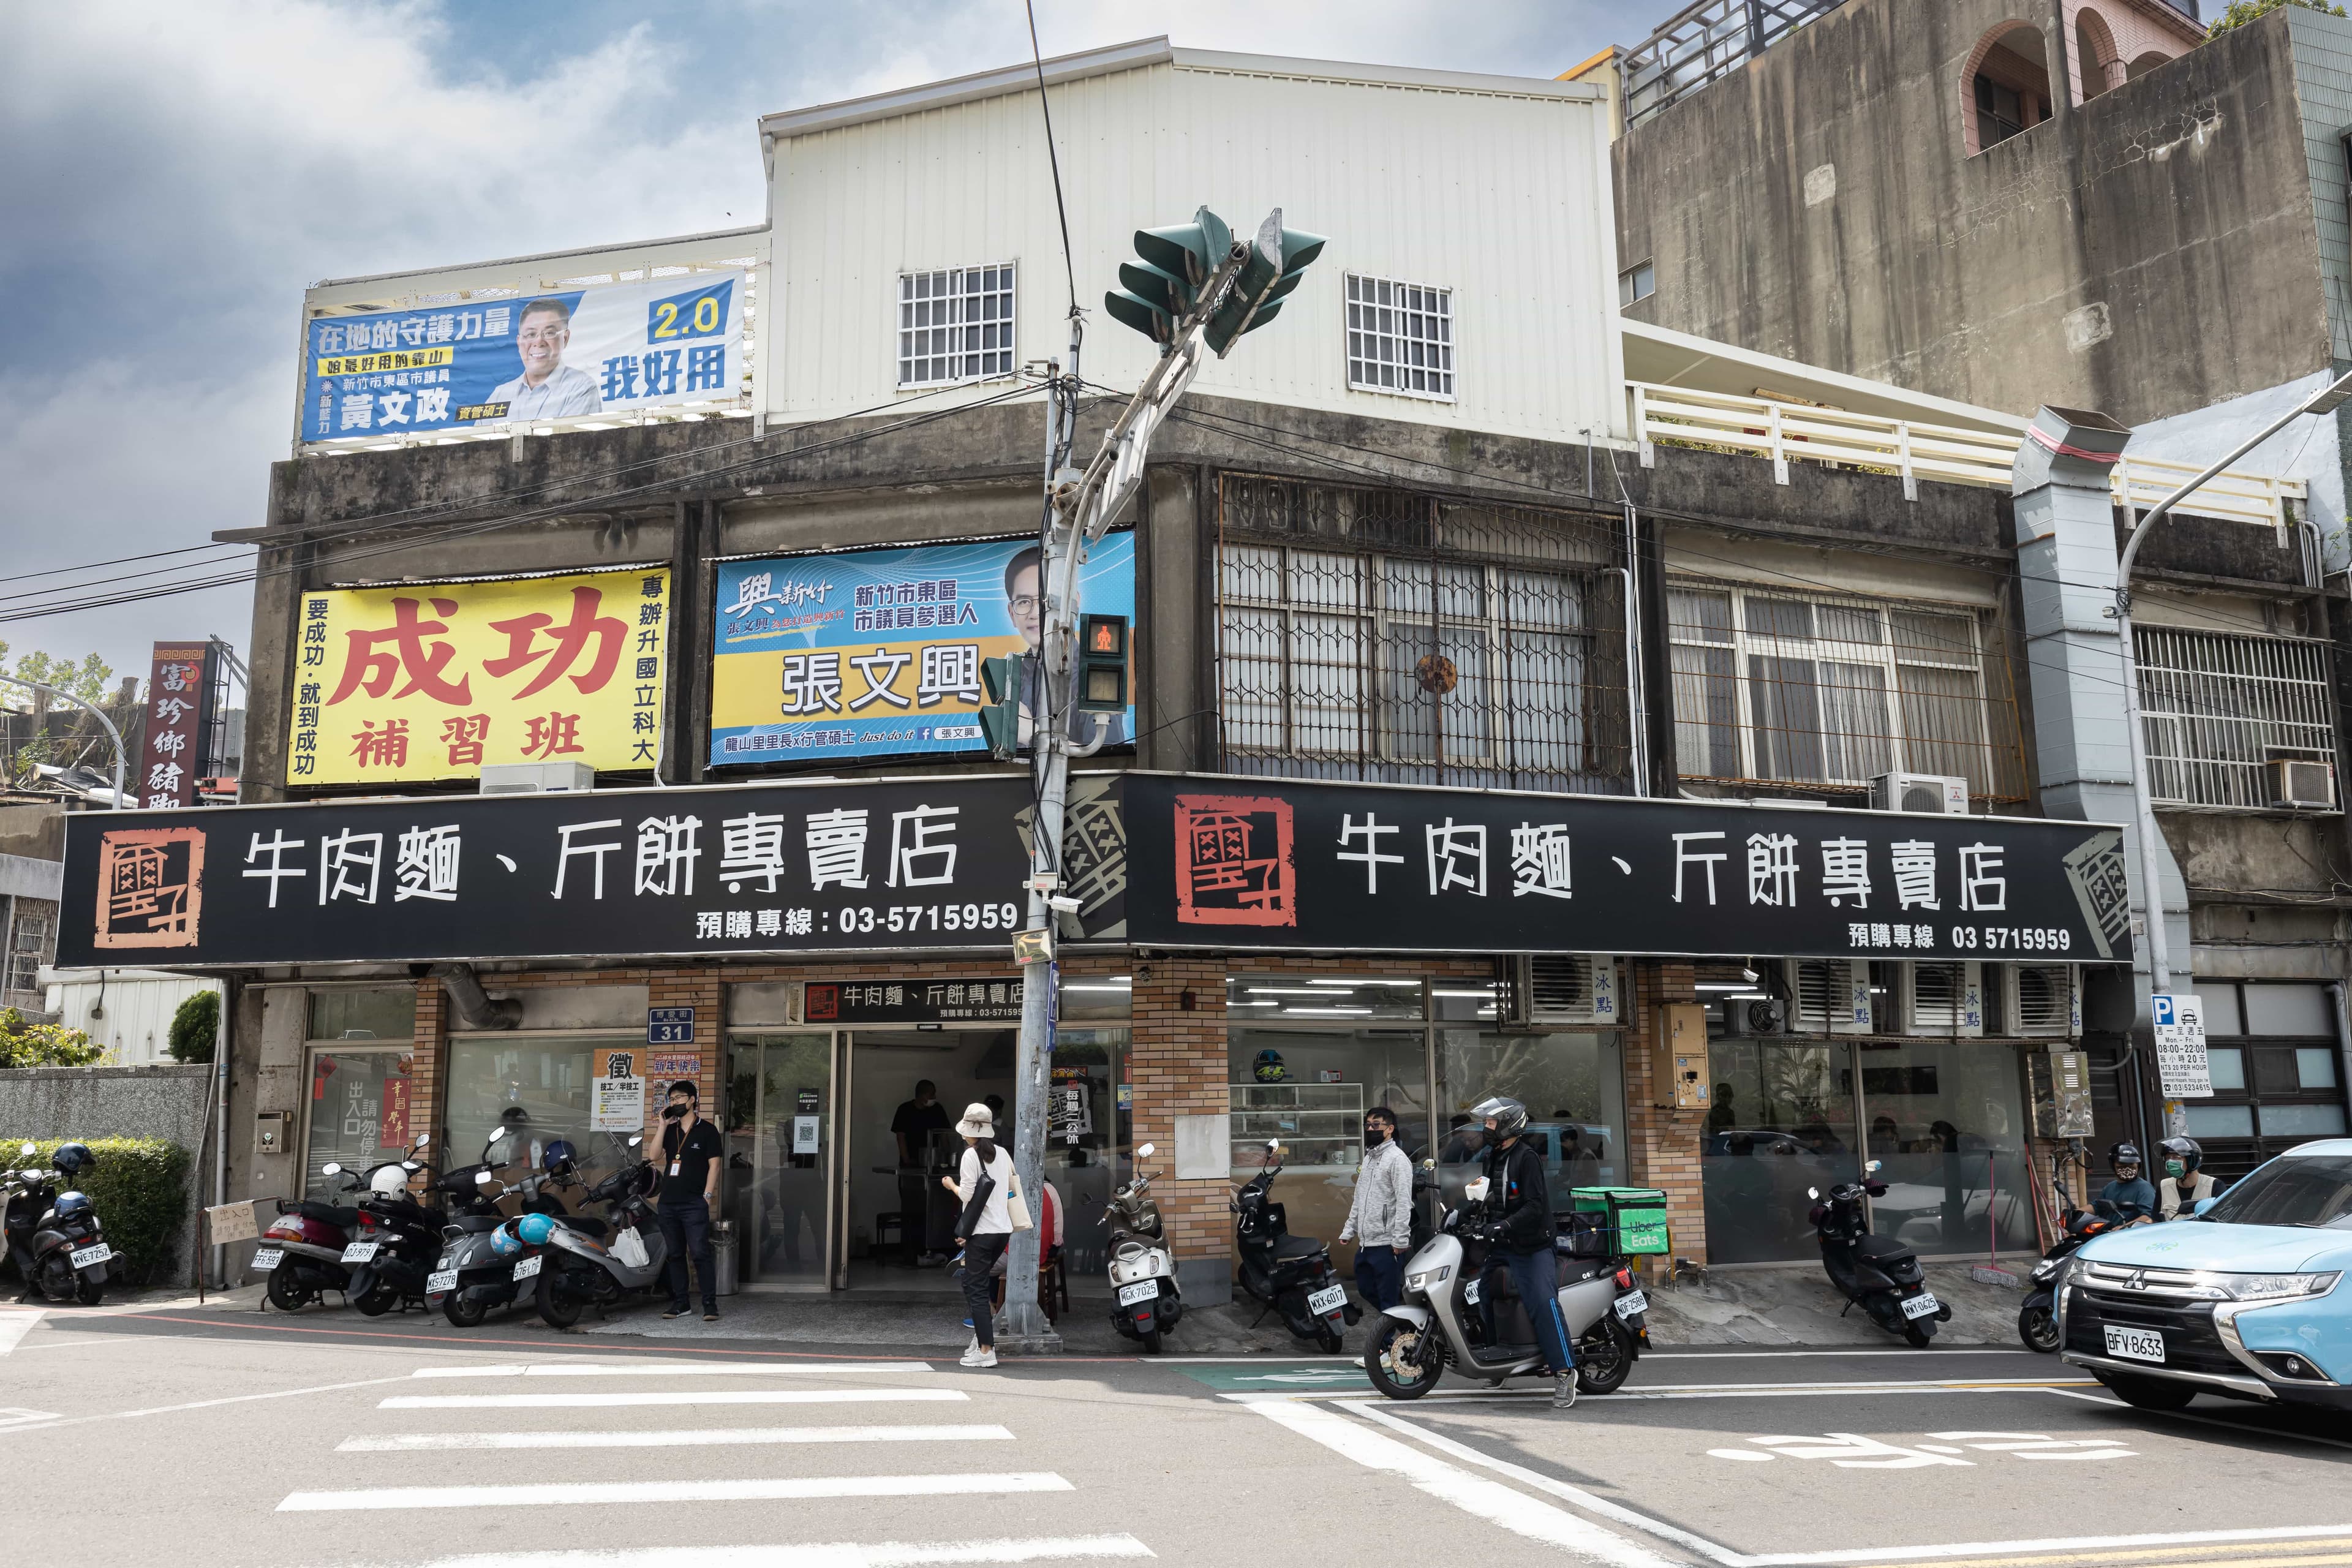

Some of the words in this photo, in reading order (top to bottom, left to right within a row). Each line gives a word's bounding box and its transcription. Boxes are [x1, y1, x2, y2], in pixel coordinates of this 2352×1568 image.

[318, 307, 511, 354] 在地的守護力量
[655, 298, 719, 338] 2.0
[327, 350, 443, 374] 咱最好用的靠山
[601, 345, 726, 402] 我好用
[343, 369, 450, 391] 新竹市東區市議員
[318, 394, 333, 434] 新藍力
[340, 387, 450, 431] 黃文政
[458, 402, 507, 420] 資管碩士
[854, 579, 957, 608] 新竹市東區
[726, 618, 768, 636] 張文興
[771, 609, 845, 629] 為您打造興新竹
[854, 602, 979, 632] 市議員參選人
[325, 586, 628, 706] 成功
[632, 576, 664, 762] 專辦升國立科大
[783, 644, 981, 715] 張文興
[349, 712, 584, 767] 補習班
[859, 731, 884, 743] Just
[887, 731, 902, 741] do
[904, 730, 914, 740] it
[941, 728, 975, 738] 張文興
[243, 804, 960, 908] 牛肉麵、斤餅專賣店
[1336, 812, 2005, 911] 牛肉麵、斤餅專賣店
[1849, 923, 1934, 948] 預購專線
[1952, 926, 1978, 949] 03
[1985, 927, 2071, 951] 5715959
[1596, 974, 1612, 1014] 冰點
[1854, 987, 1869, 1024] 冰點
[1966, 990, 1980, 1027] 冰點
[2154, 998, 2171, 1023] P
[662, 1026, 681, 1039] 31
[2155, 1027, 2204, 1035] 週一至週五
[2158, 1044, 2205, 1054] 08:00-22:00
[608, 1053, 633, 1079] 徵
[654, 1060, 700, 1071] 新年快樂
[344, 1081, 363, 1135] 出入口
[1066, 1090, 1079, 1145] 每週二公休
[358, 1099, 377, 1170] 請勿停車
[220, 1208, 249, 1221] 出入口
[1630, 1221, 1656, 1233] Uber
[1632, 1234, 1659, 1247] Eats
[74, 1248, 109, 1265] MVE-7252
[428, 1275, 456, 1288] MXS-7278
[1121, 1284, 1156, 1303] MGK-7025
[1311, 1290, 1343, 1311] MXX-6017
[2106, 1332, 2163, 1357] BFV-8633
